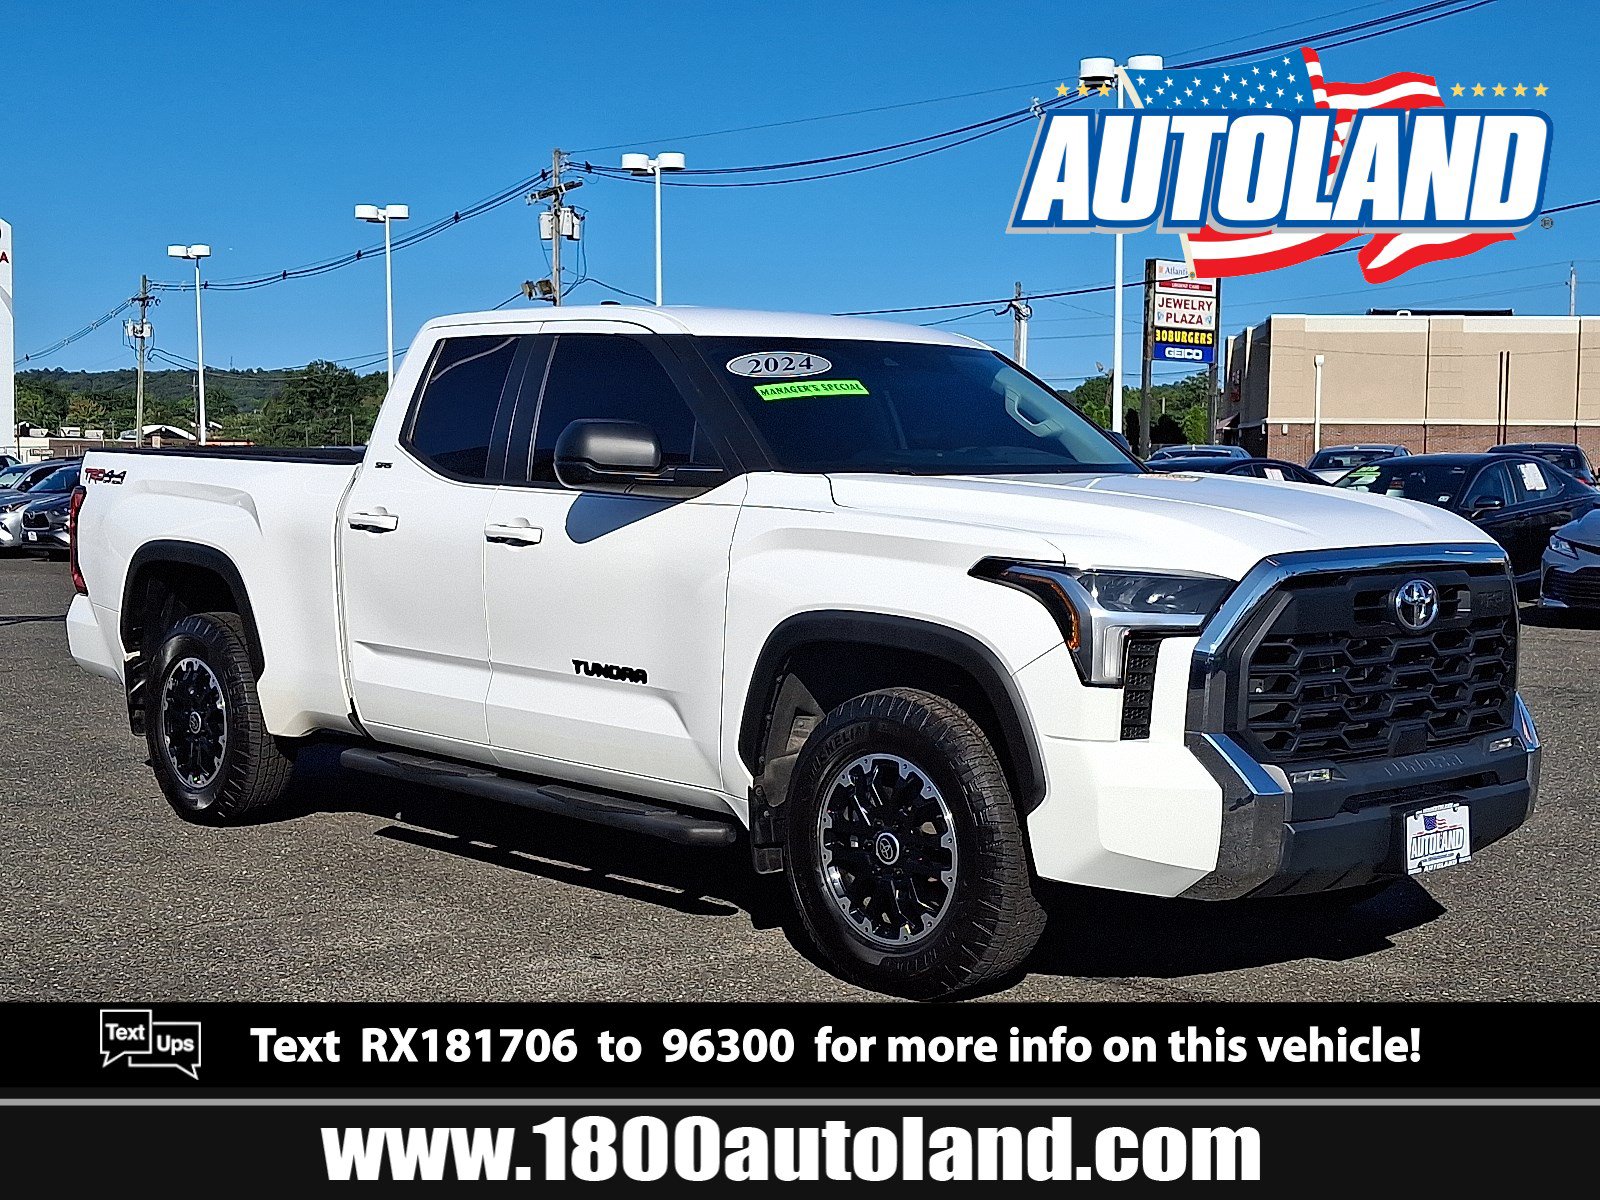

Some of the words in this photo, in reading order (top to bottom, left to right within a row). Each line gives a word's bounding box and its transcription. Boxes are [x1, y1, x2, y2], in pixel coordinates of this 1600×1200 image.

[1164, 266, 1188, 275] Atlanti
[1158, 297, 1213, 311] JEWELRY
[1165, 312, 1203, 325] PLAZA
[1164, 347, 1203, 360] GEICO
[747, 356, 814, 374] 2024
[759, 384, 819, 397] MANAGER'S
[820, 382, 864, 393] SPECIAL
[572, 659, 647, 684] TUNDRA
[1410, 827, 1465, 860] AUTOLAND
